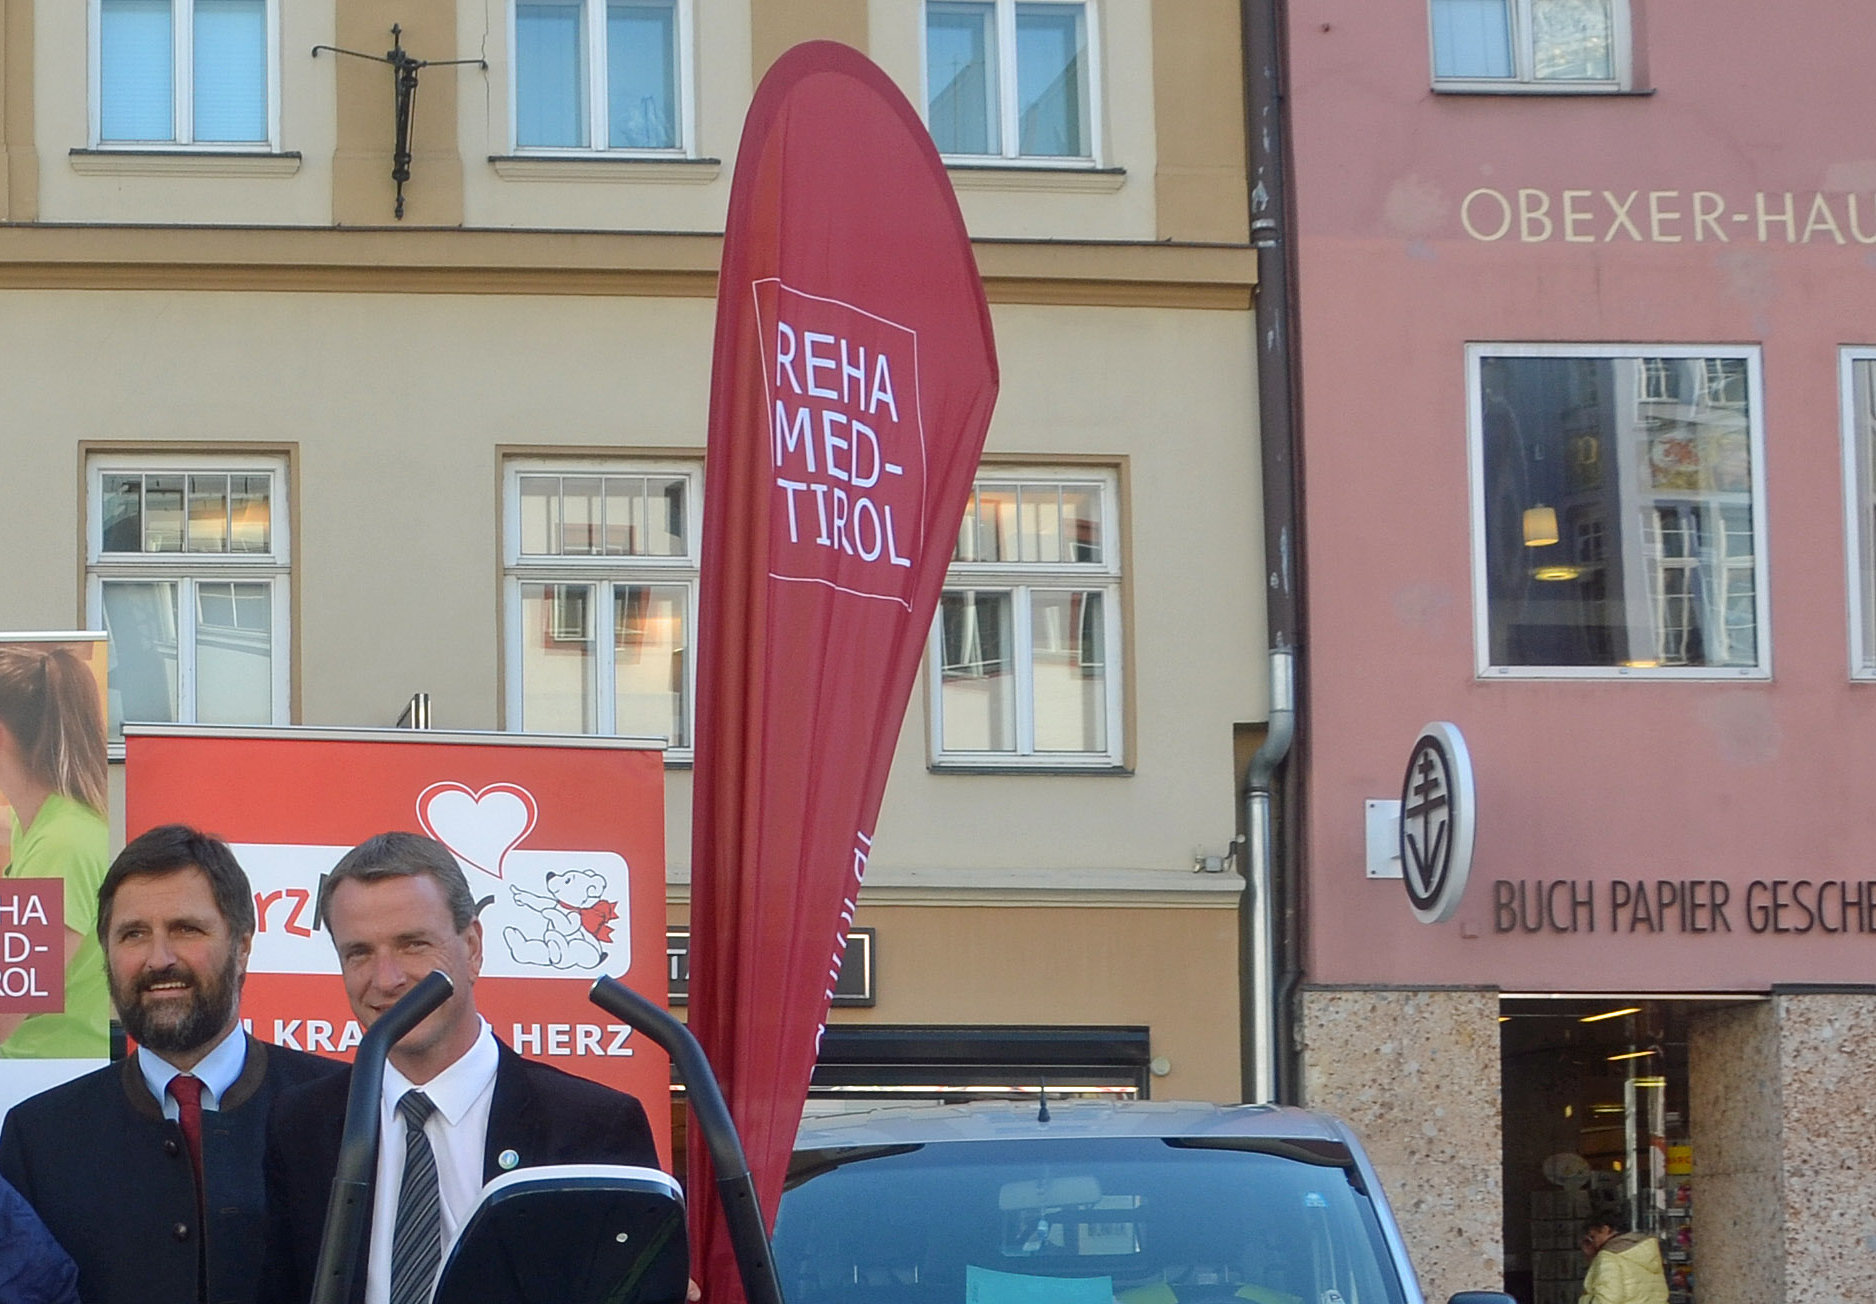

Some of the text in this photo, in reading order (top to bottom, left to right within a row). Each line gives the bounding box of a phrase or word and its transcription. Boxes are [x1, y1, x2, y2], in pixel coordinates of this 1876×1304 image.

[775, 320, 900, 423] REHA
[775, 399, 904, 489] MED-
[776, 478, 912, 569] TIROL
[1493, 880, 1876, 935] BUCH PAPIER GESCHE
[513, 1024, 634, 1056] HERZ
